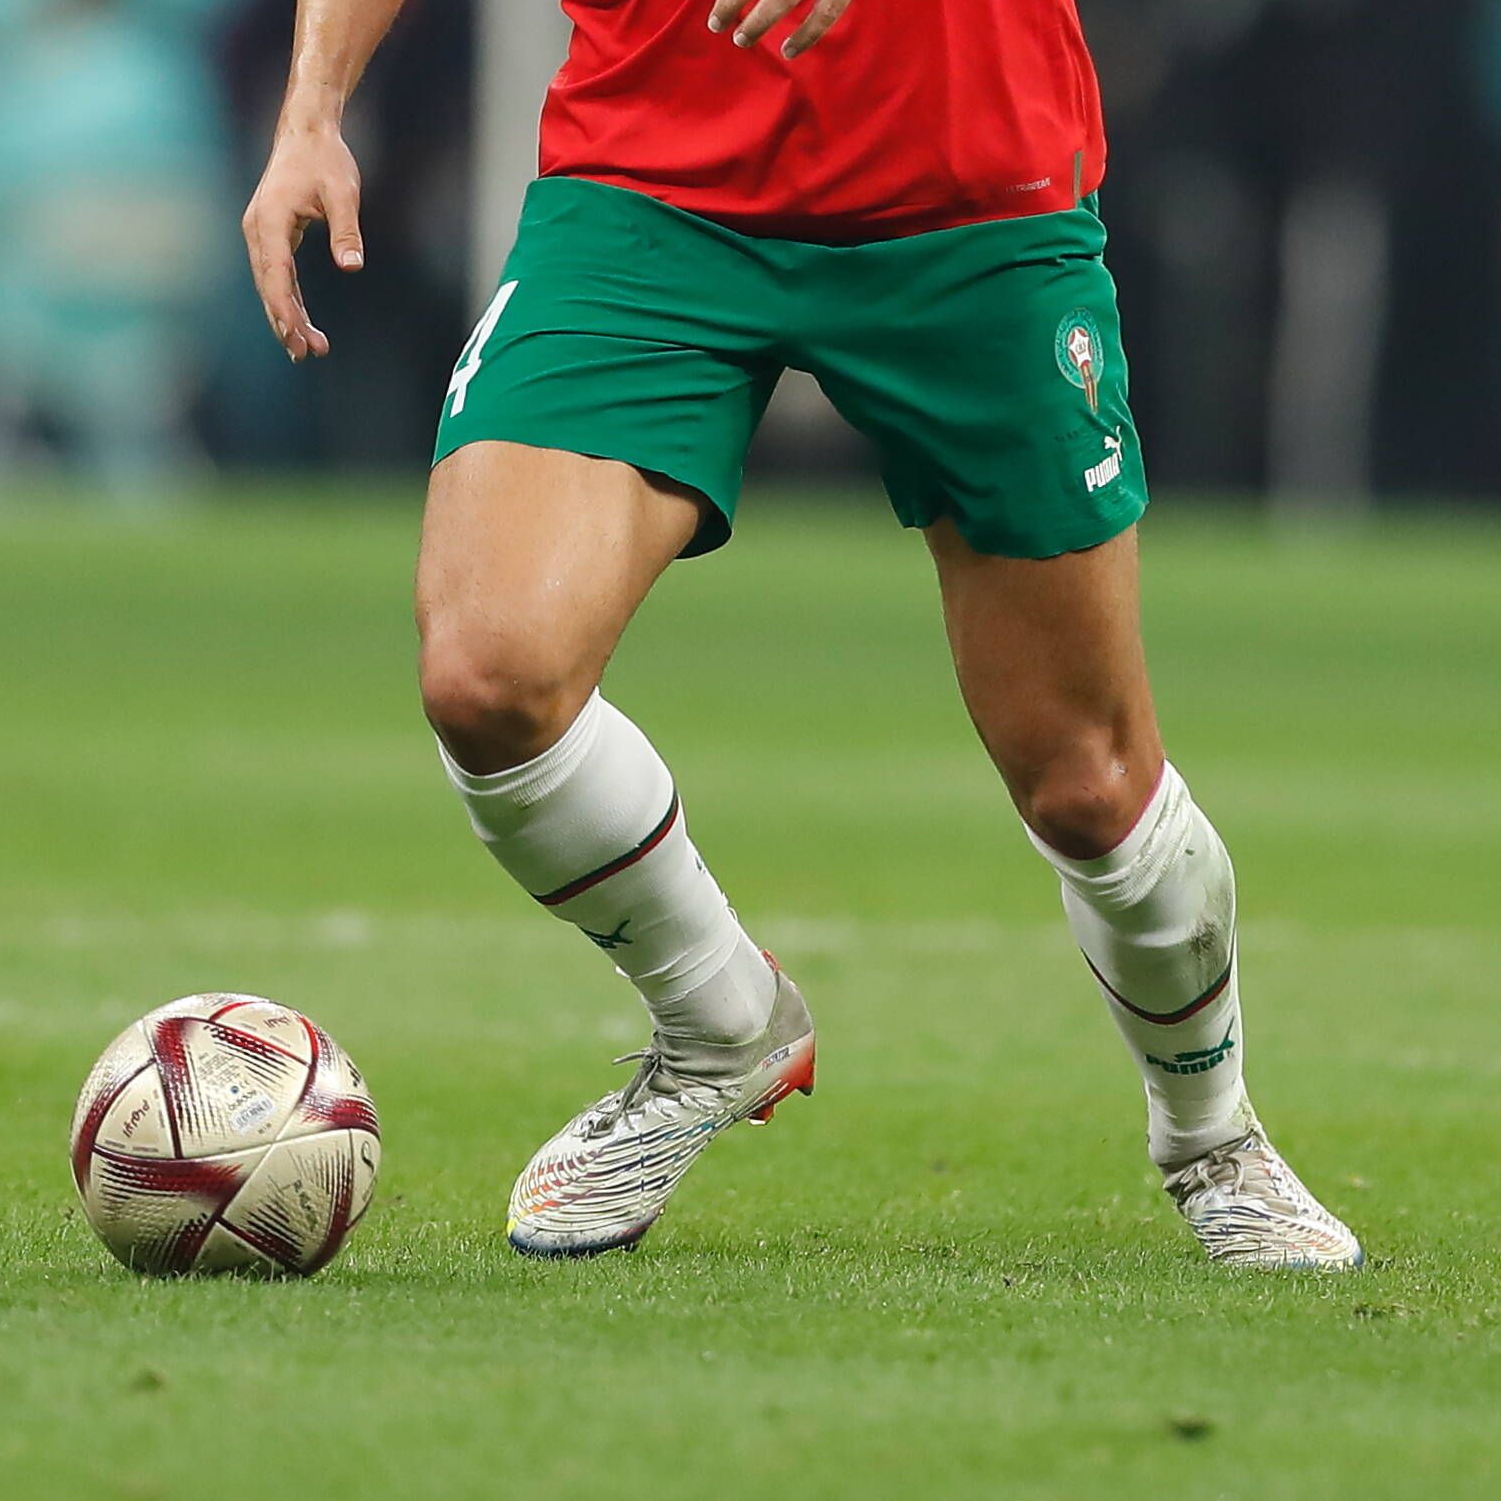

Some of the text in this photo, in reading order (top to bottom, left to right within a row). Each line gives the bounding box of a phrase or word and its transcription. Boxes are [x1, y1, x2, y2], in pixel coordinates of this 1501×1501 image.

[446, 279, 519, 418] 4
[1084, 451, 1121, 493] PUMA
[1145, 1052, 1225, 1075] PUMA
